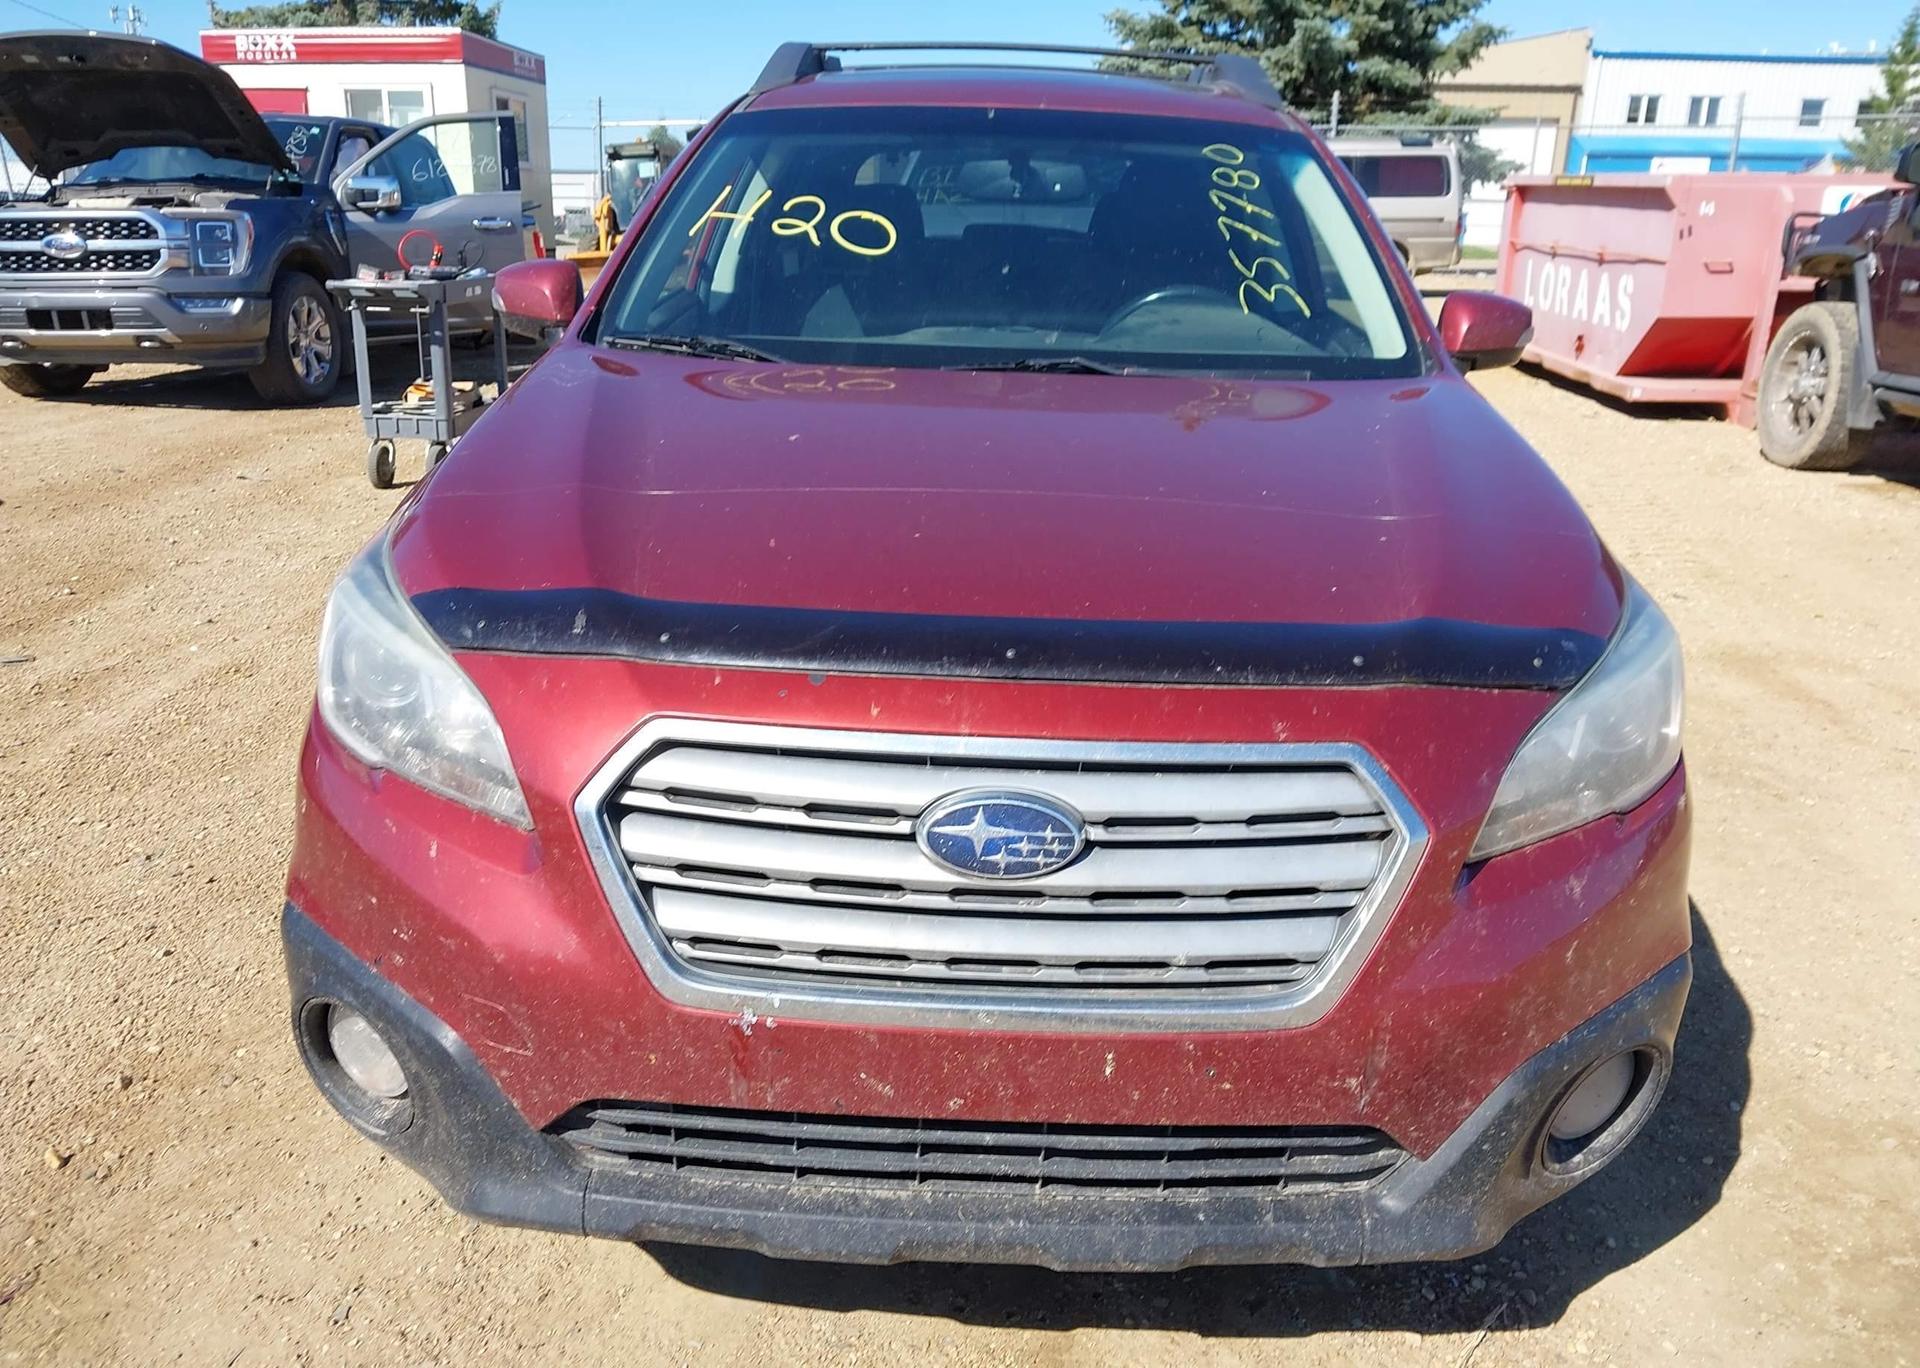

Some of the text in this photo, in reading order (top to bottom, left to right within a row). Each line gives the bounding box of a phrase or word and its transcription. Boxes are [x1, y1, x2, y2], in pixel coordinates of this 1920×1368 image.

[235, 34, 297, 51] BOXX
[236, 51, 297, 60] MODULAR
[1524, 257, 1635, 333] LORAAS
